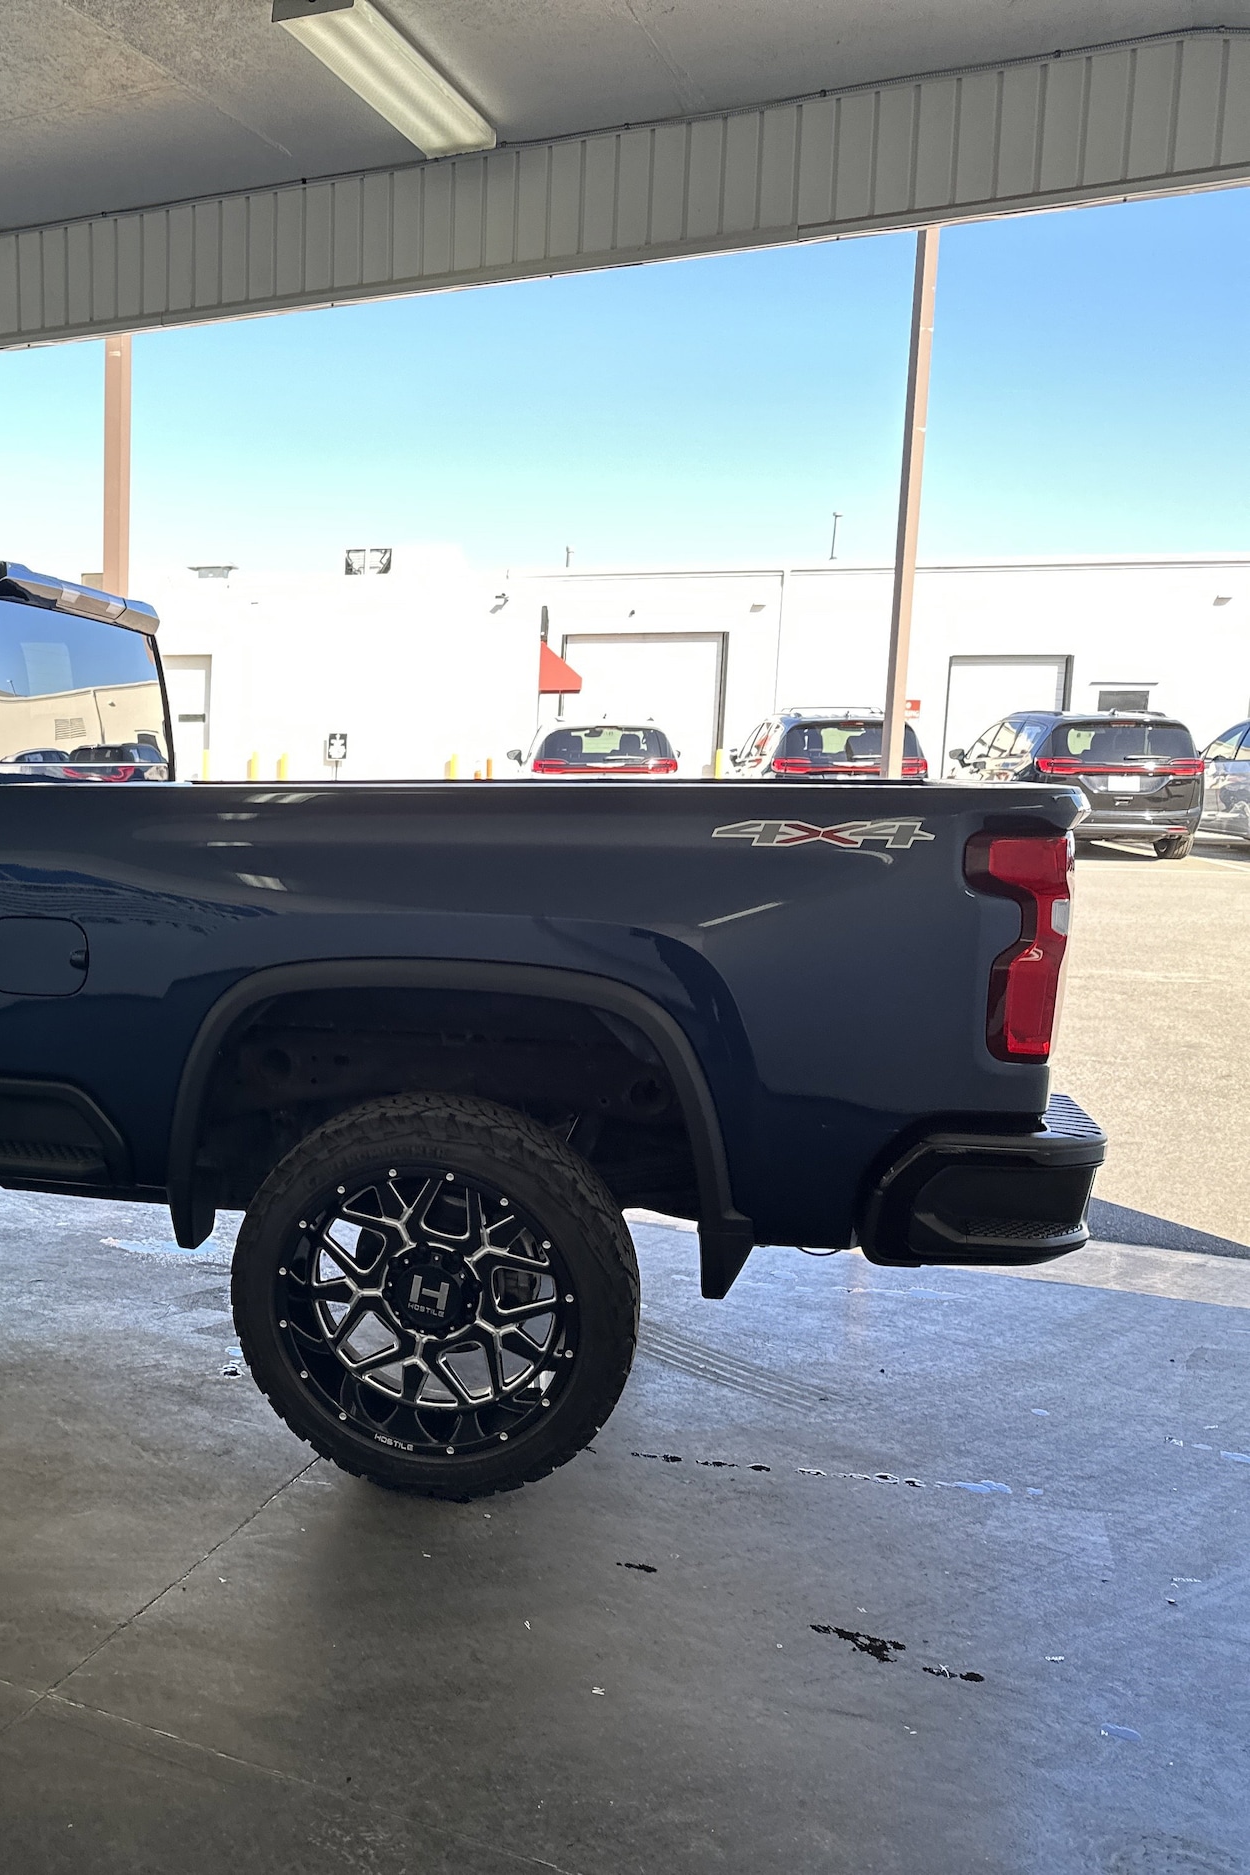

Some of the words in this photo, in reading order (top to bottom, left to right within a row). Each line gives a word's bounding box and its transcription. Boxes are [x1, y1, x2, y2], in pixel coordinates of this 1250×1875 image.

[409, 1274, 450, 1311] H
[407, 1302, 445, 1318] HOSTILE
[374, 1433, 414, 1452] HOSTILE
